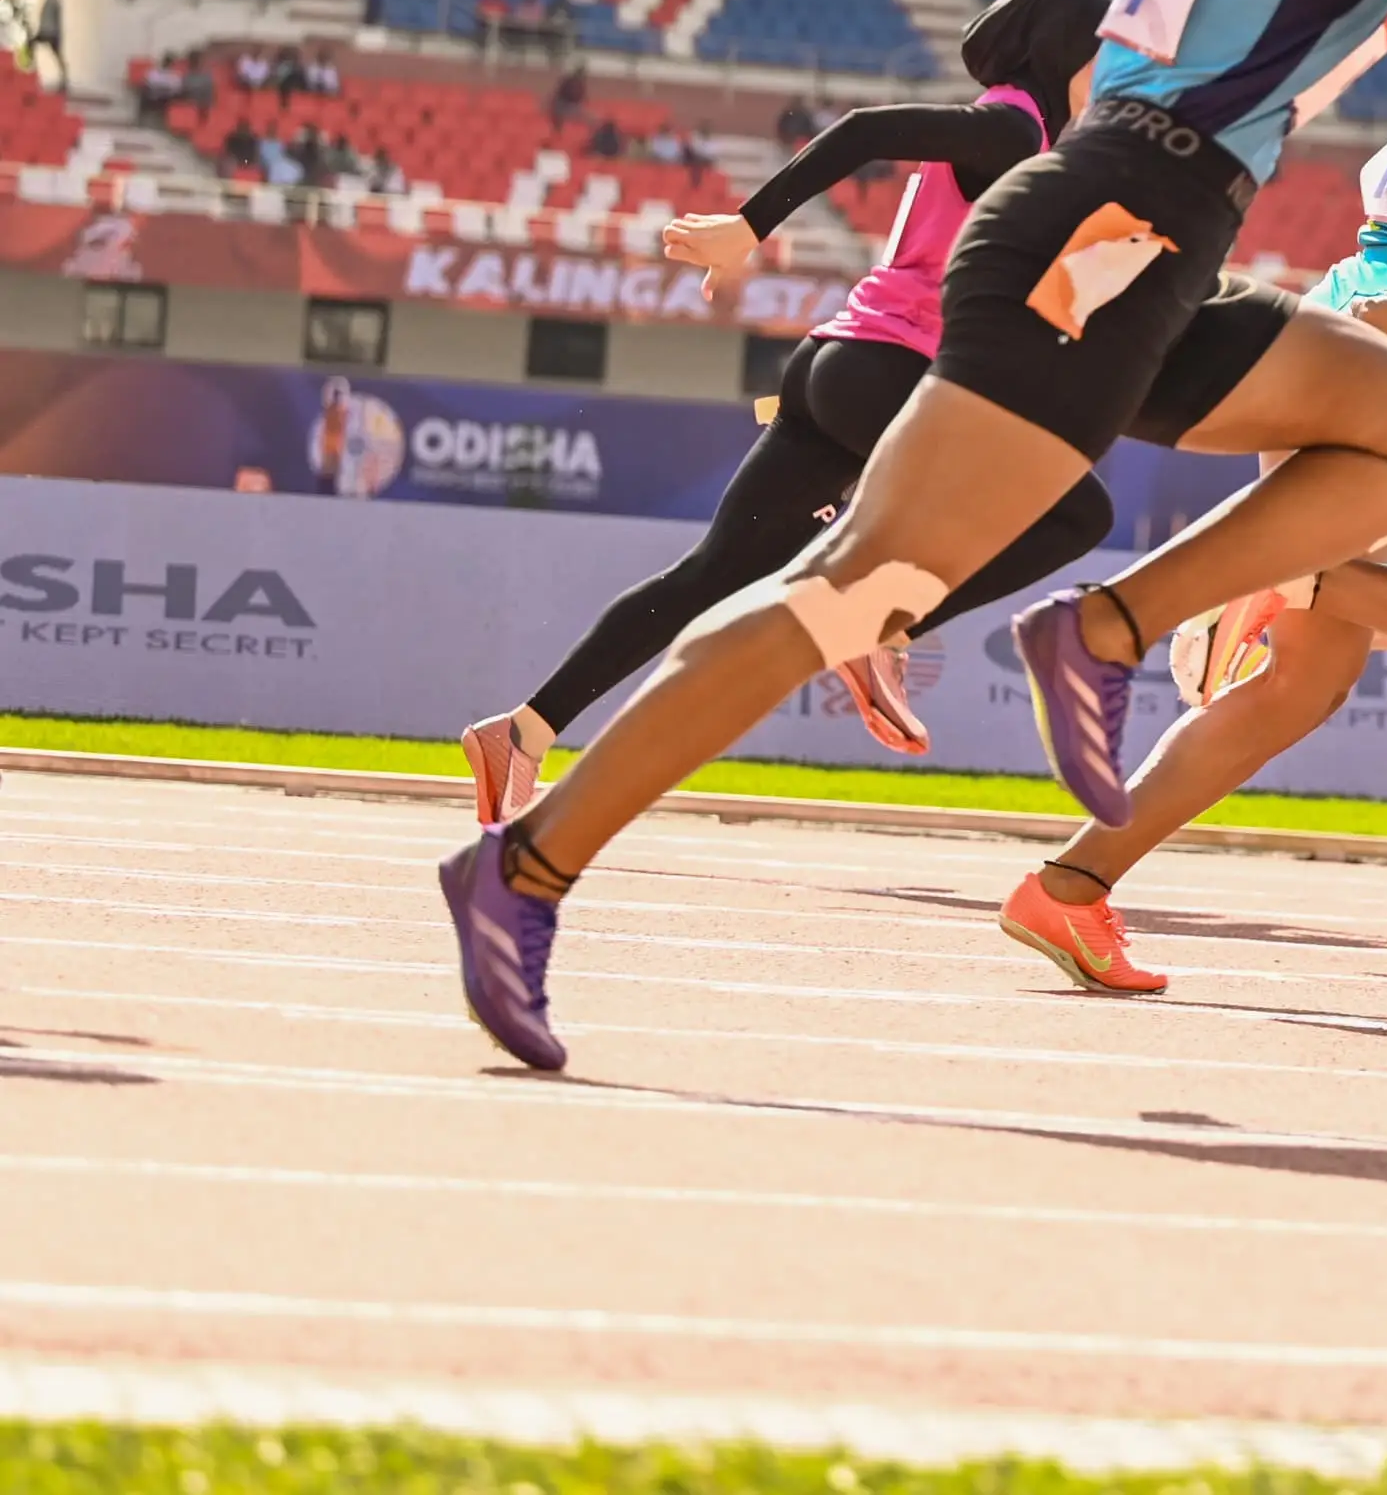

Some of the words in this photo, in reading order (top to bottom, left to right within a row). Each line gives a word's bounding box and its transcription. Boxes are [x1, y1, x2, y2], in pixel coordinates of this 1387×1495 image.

[405, 245, 711, 317] KALINGA
[410, 415, 603, 481] ODISHA
[21, 620, 130, 648] KEPT
